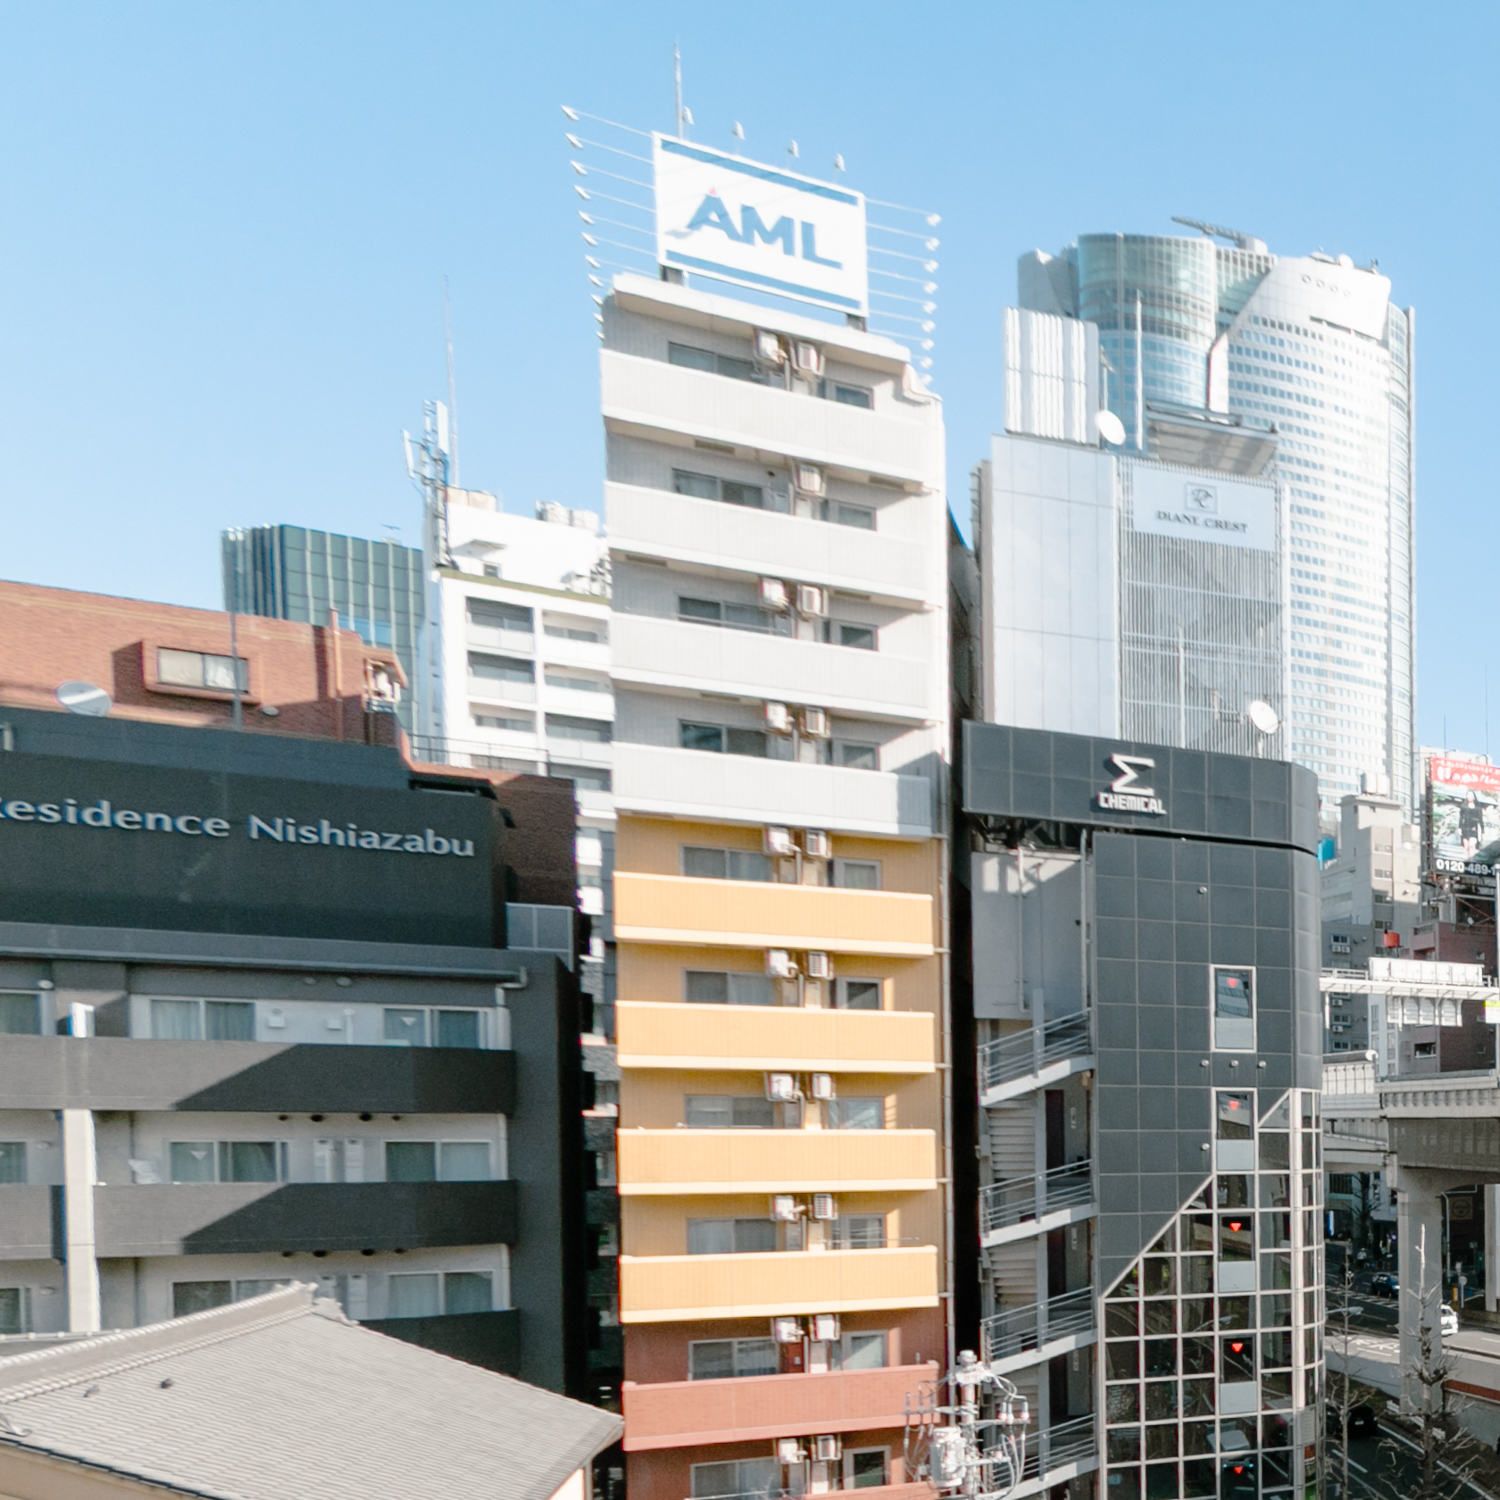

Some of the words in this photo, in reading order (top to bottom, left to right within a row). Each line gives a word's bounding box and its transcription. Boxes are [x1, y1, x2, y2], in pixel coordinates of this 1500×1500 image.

[682, 190, 843, 270] AML
[1157, 510, 1199, 527] DIANE
[1204, 518, 1248, 533] CREST
[1097, 792, 1167, 815] CHEMICAL
[0, 798, 231, 838] esidence
[247, 814, 475, 857] Nishiazabu
